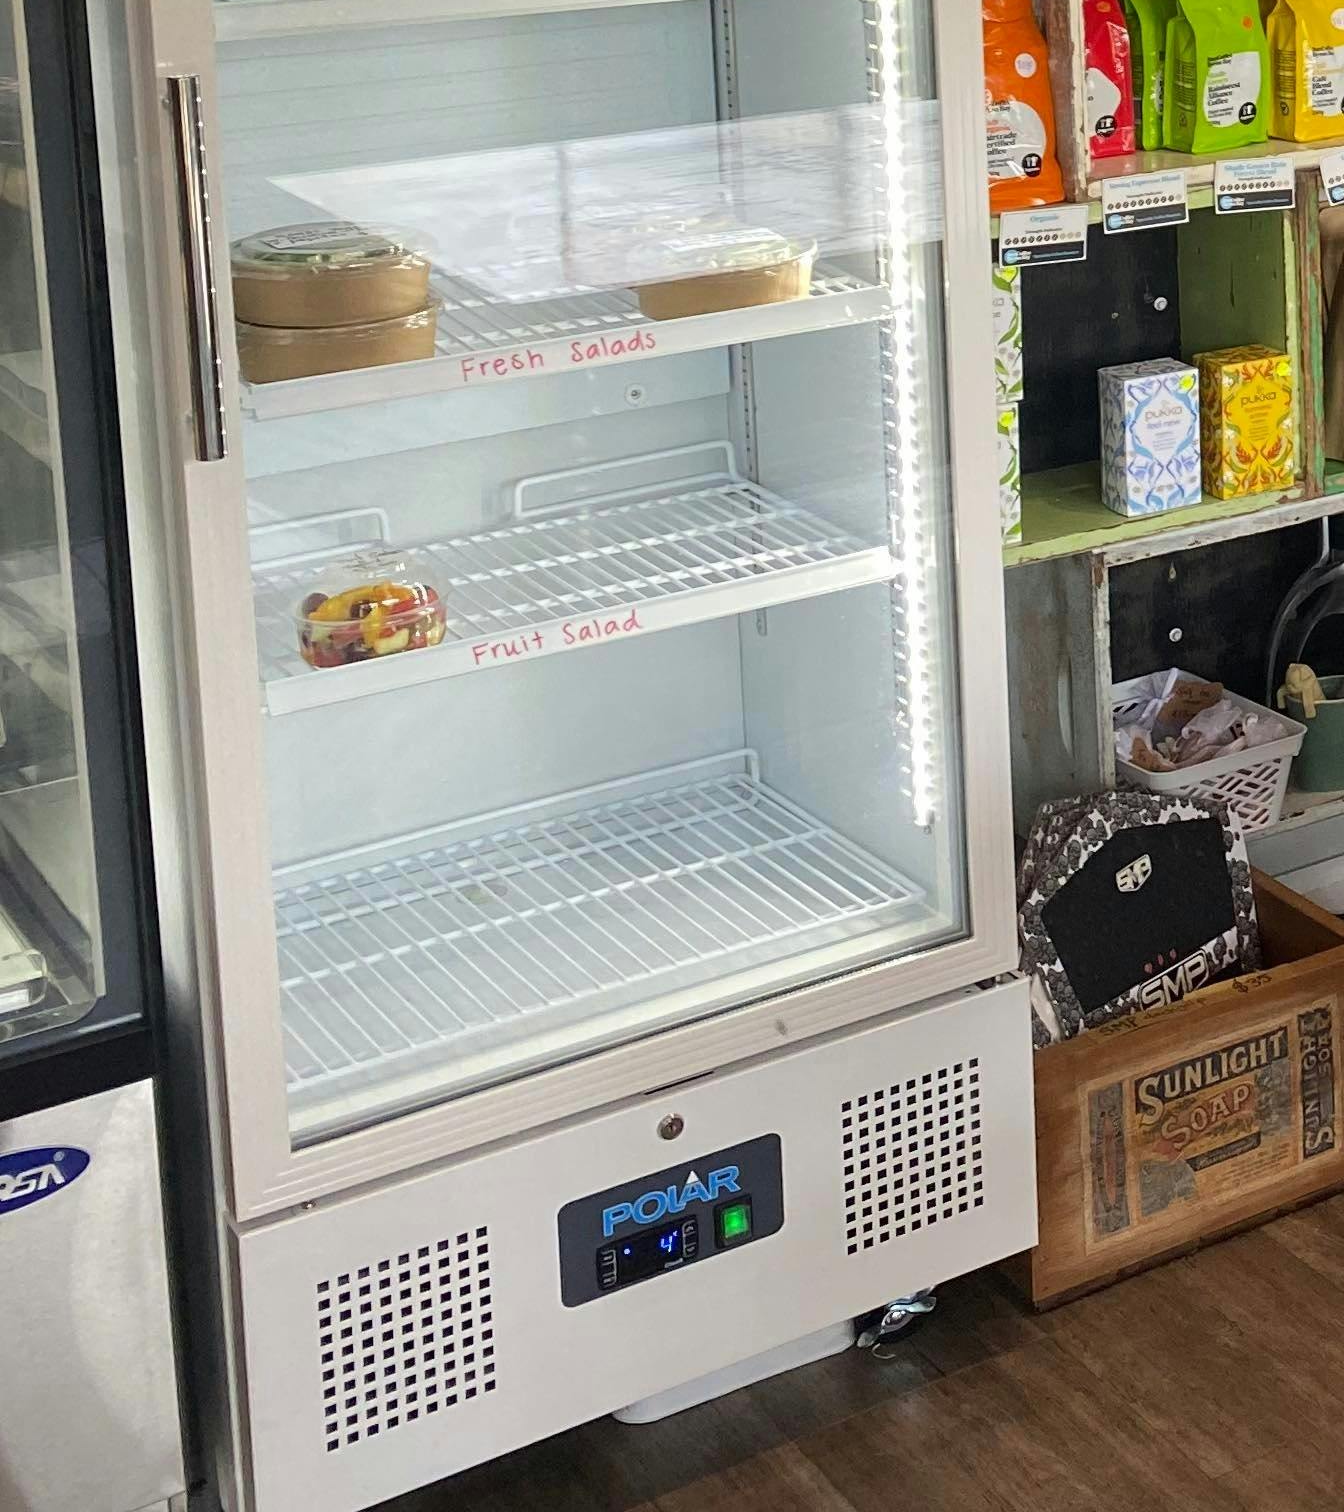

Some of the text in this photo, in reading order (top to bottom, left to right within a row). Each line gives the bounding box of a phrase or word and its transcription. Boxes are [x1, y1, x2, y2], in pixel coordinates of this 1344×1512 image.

[1312, 81, 1332, 89] Blend
[1312, 88, 1333, 96] Coffee
[1208, 98, 1229, 106] Coffee
[986, 131, 1017, 141] airtrade
[986, 147, 1008, 156] offee
[461, 330, 657, 382] Fresh Salads
[1240, 391, 1277, 407] pukka
[1144, 405, 1183, 421] pukka
[471, 609, 643, 666] Fruit Salad
[1140, 953, 1208, 1010] SMP
[1137, 1029, 1289, 1128] SUNLIGHT
[1160, 1082, 1252, 1152] SOAP
[603, 1165, 742, 1238] POLAR
